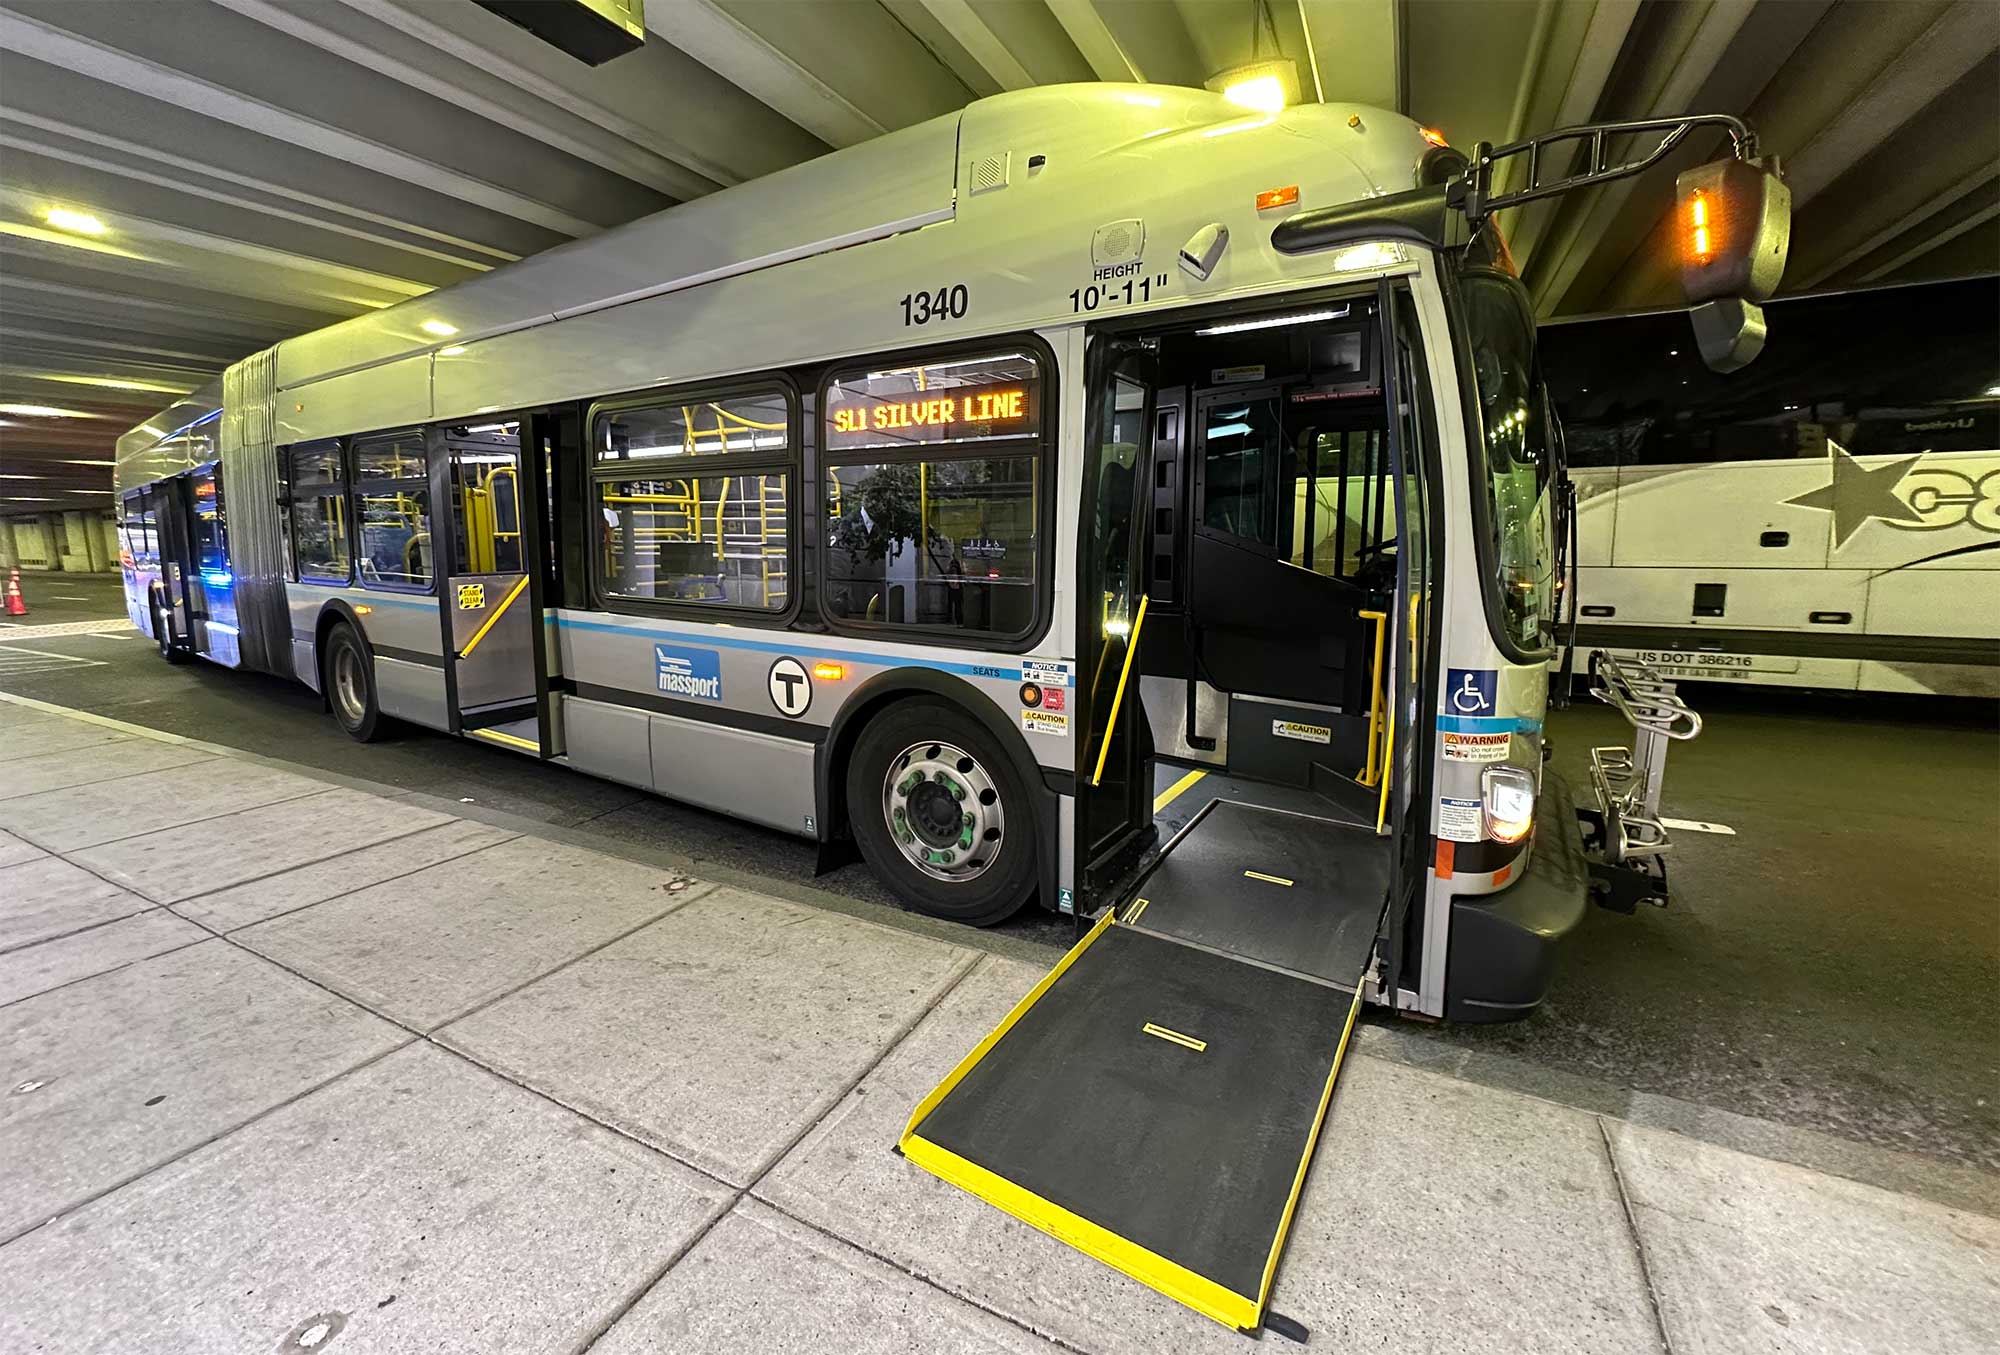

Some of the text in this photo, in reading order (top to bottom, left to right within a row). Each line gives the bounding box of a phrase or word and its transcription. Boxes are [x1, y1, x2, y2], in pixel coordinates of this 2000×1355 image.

[1093, 262, 1143, 281] HEIGHT
[900, 284, 968, 326] 1340
[834, 391, 1024, 433] SL1 SILVER LINE
[1031, 662, 1059, 671] NOTICE
[1636, 651, 1753, 667] US DOT 386216
[972, 666, 1001, 678] SEATS
[659, 672, 719, 698] massport
[775, 672, 804, 708] T
[1031, 712, 1065, 724] CAUTION
[1292, 724, 1329, 736] CAUTION
[1459, 735, 1509, 746] WARNING
